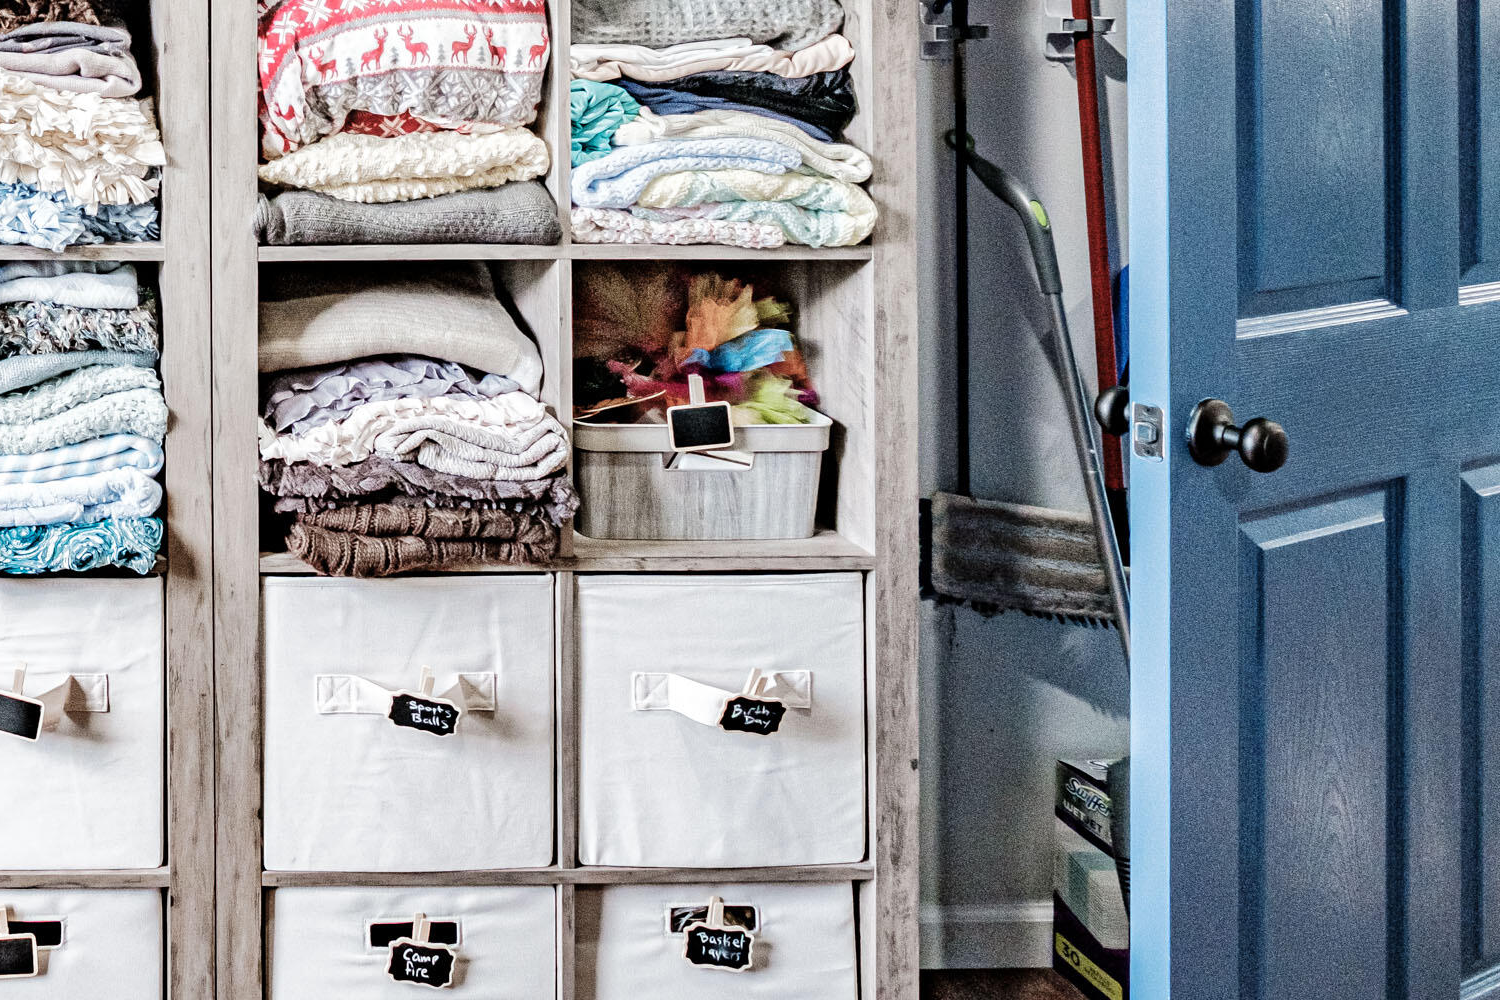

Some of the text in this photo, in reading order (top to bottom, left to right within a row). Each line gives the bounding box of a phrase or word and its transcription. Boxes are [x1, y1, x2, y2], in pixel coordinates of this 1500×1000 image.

[408, 700, 452, 719] Sports
[410, 712, 450, 730] Balls
[743, 715, 771, 729] Day
[696, 931, 746, 950] Basket
[402, 948, 440, 966] Camp
[1061, 941, 1081, 967] 30
